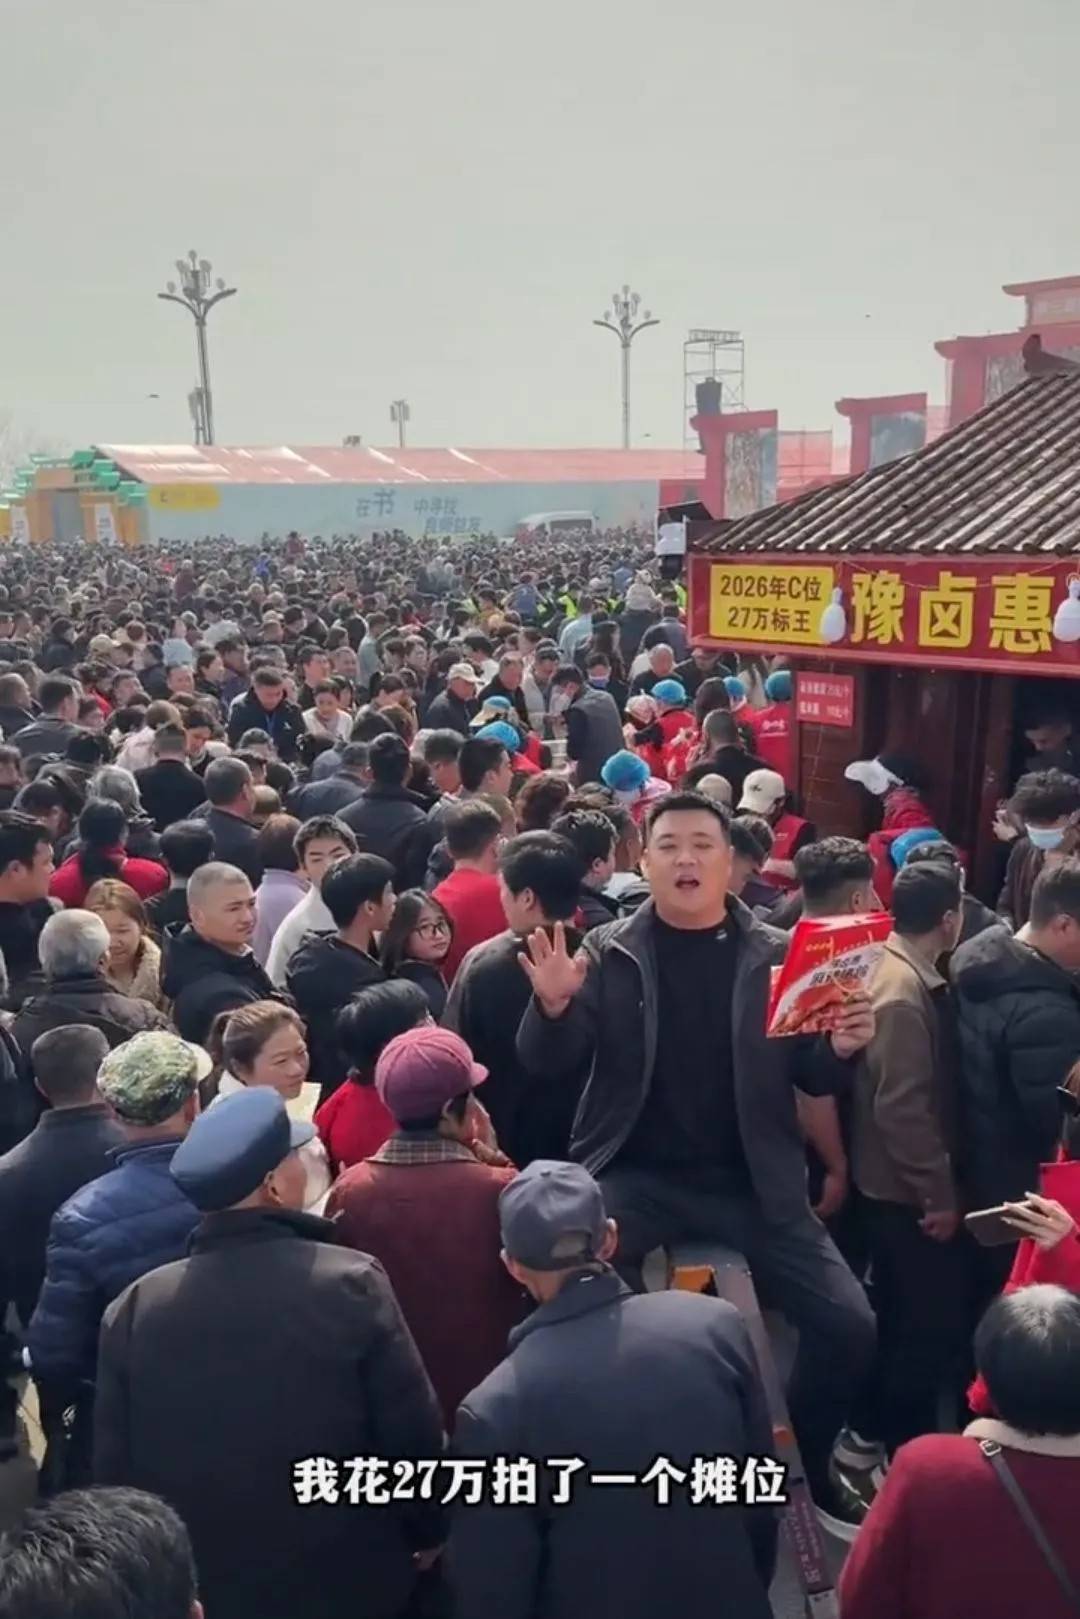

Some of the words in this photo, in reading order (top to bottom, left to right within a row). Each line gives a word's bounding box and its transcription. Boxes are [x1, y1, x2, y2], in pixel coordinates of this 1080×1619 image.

[719, 574, 823, 602] 2026年C位
[727, 606, 812, 633] 27万标王
[850, 569, 1056, 654] 豫卤惠
